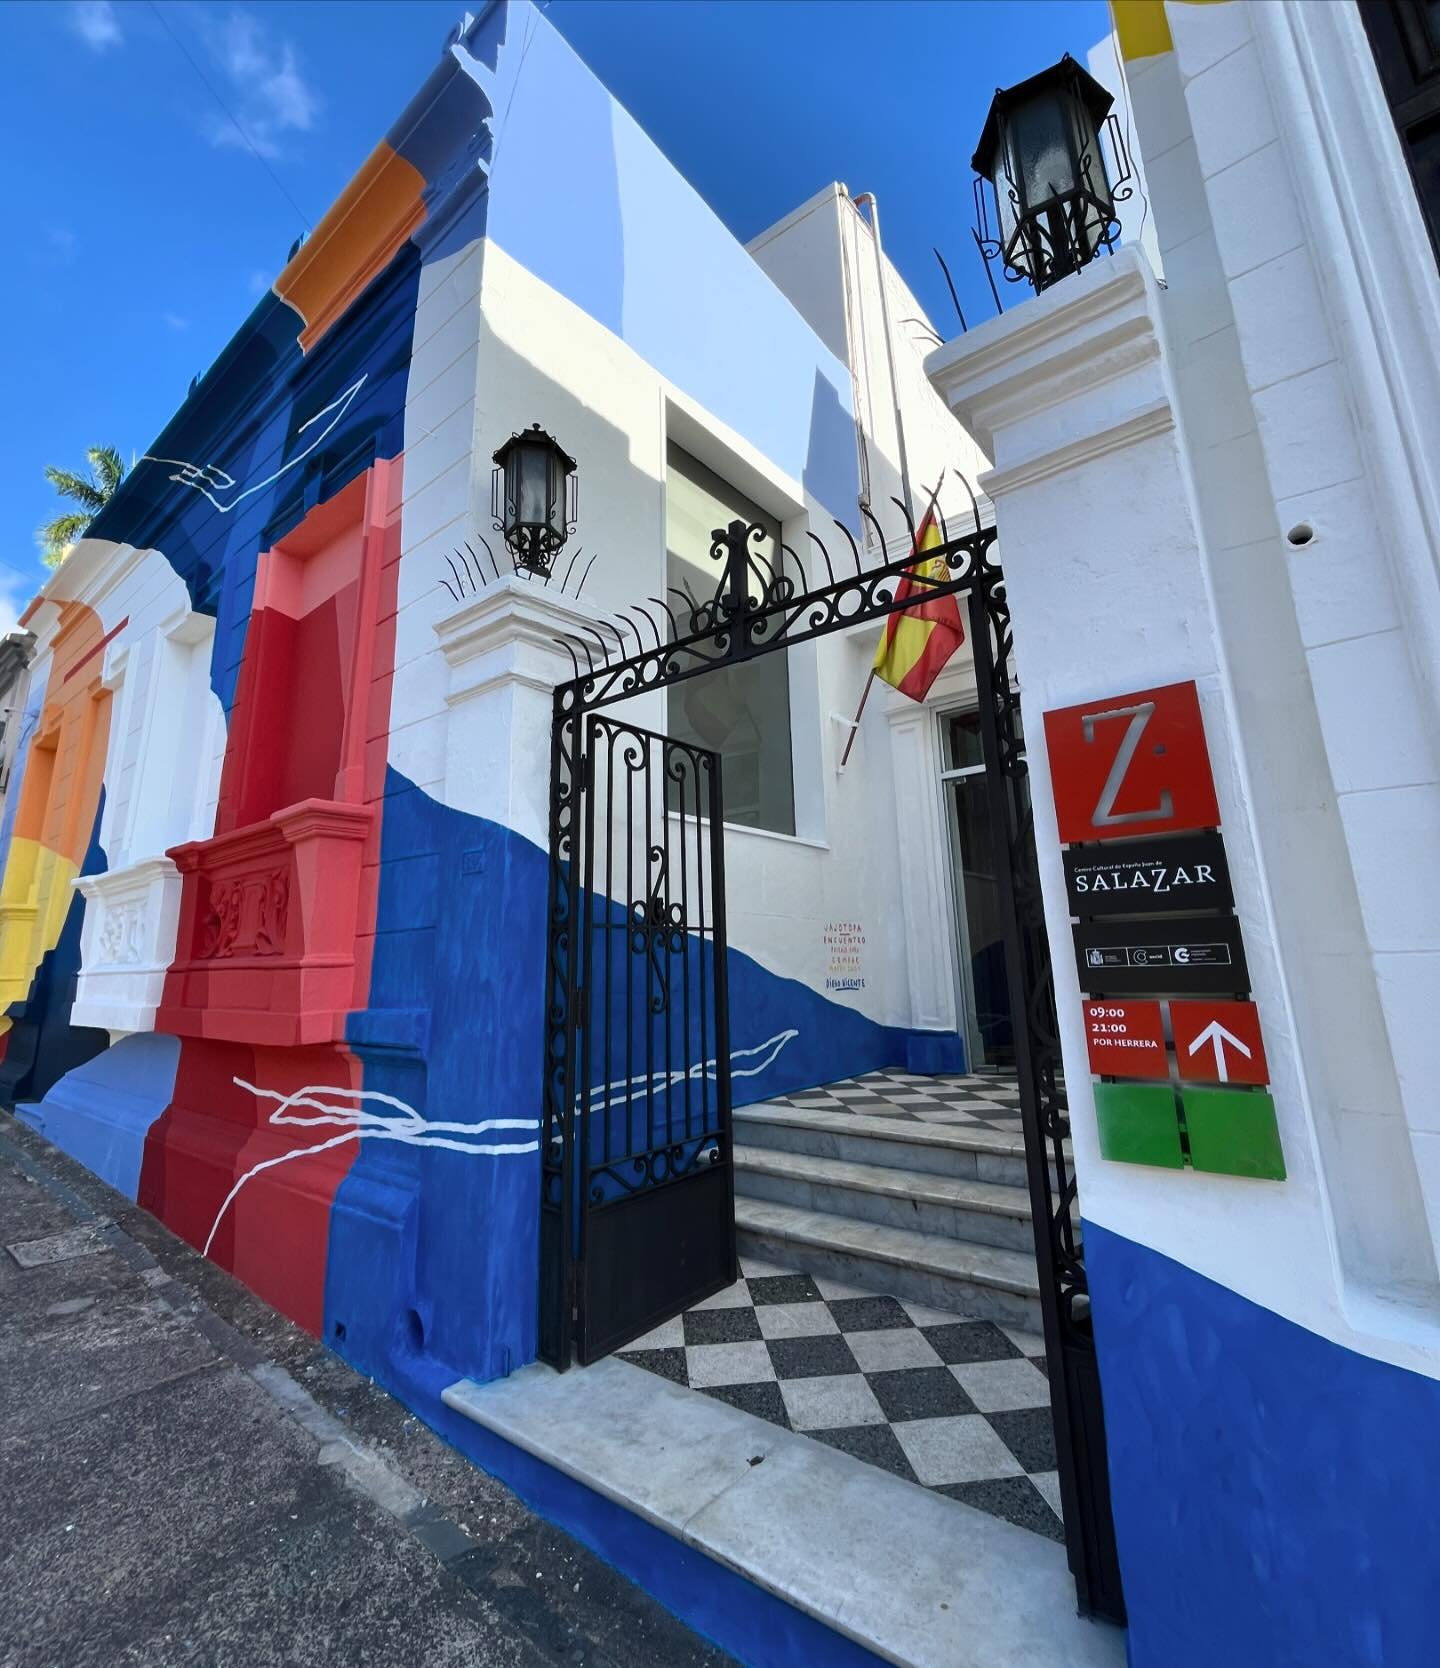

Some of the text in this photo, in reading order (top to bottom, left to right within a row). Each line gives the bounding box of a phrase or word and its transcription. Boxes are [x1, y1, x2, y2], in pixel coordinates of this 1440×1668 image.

[1076, 865, 1216, 892] SALAZAR
[1090, 1007, 1125, 1018] 09:00
[1092, 1023, 1127, 1033] 21:00
[1093, 1038, 1158, 1048] POR HERRERA
